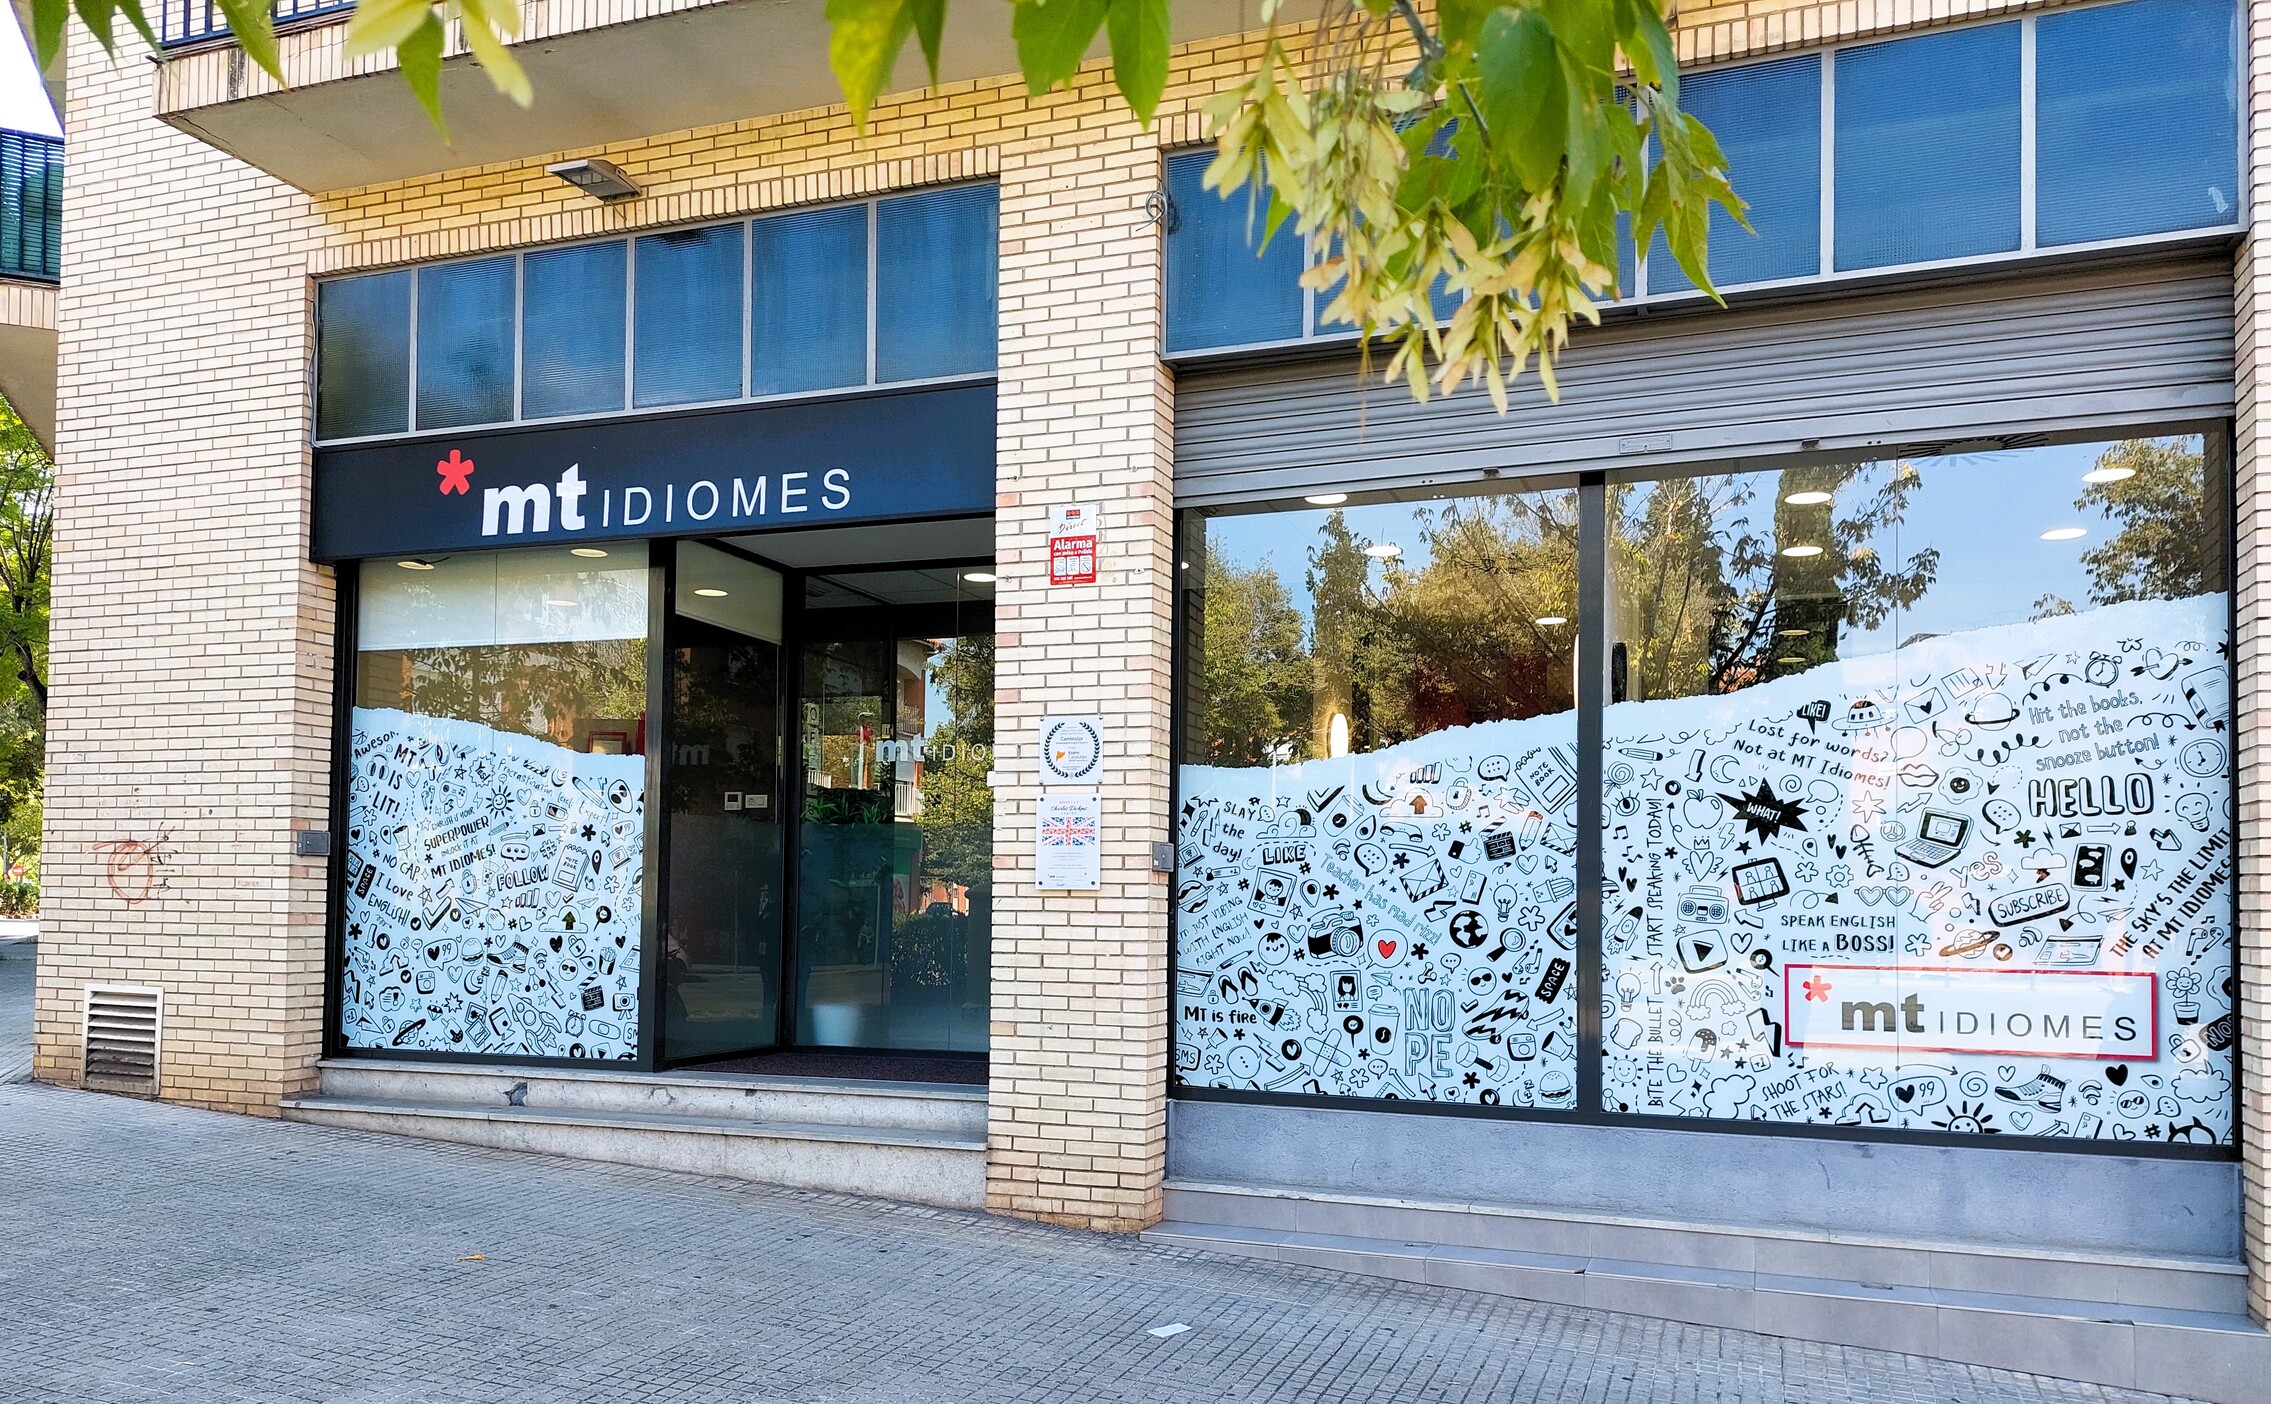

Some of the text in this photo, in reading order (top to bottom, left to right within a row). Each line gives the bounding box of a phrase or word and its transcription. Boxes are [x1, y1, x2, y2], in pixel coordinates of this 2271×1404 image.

[481, 462, 852, 537] mt IDIOMES
[1053, 539, 1093, 550] Alarma
[1801, 701, 1827, 718] LIKE!
[2028, 706, 2054, 725] Hit
[2058, 700, 2087, 719] the
[1749, 719, 1889, 763] Lost for words?
[2058, 717, 2124, 743] not the
[394, 743, 417, 767] MT
[876, 733, 987, 762] mt IDIO
[2036, 732, 2160, 772] snooze button!
[1529, 761, 1549, 780] NOTE
[1535, 767, 1555, 787] BOOK
[1733, 739, 1891, 790] Not at MT Idiomes!
[388, 770, 402, 790] IS
[372, 791, 400, 819] LIT!
[2028, 772, 2154, 818] HELLO
[1223, 801, 1257, 821] SLAY
[1646, 798, 1665, 849] TODAY!
[1746, 802, 1782, 824] WHAT!
[424, 815, 490, 851] SUPERPOWER
[1222, 822, 1245, 839] the
[382, 854, 398, 868] NO
[431, 843, 497, 879] MT IDIOMES!
[1213, 841, 1243, 863] day!
[1262, 845, 1307, 866] LIKE
[357, 867, 374, 895] SPACE
[496, 863, 550, 891] FOLLOW
[1320, 852, 1443, 946] Teacher has mad rizz!
[1997, 888, 2064, 919] SUBSCRIBE
[2110, 826, 2231, 957] THE SKY'S THE LIMIT
[1191, 914, 1209, 934] JUST
[1211, 896, 1243, 919] VIBING
[1211, 912, 1249, 939] ENGLISH
[1780, 914, 1896, 930] SPEAK ENGLISH
[1646, 914, 1664, 958] START
[1782, 933, 1895, 954] LIKE A BOSS!
[2142, 938, 2164, 959] AT
[2156, 916, 2185, 941] MT
[1195, 943, 1225, 966] RIGHT
[1540, 960, 1566, 998] SPACE
[1184, 1005, 1207, 1022] MT
[1211, 1009, 1224, 1023] is
[1403, 987, 1456, 1032] NO
[1646, 996, 1663, 1043] BULLET
[1841, 992, 2137, 1042] mt IDIOMES
[2202, 1015, 2232, 1048] NO
[1175, 1048, 1197, 1065] SMS
[1404, 1031, 1455, 1079] PE
[1646, 1048, 1664, 1075] THE
[1753, 1057, 1767, 1068] +1
[1762, 1061, 1840, 1102] SHOOT FOR
[1918, 1081, 1936, 1098] 99
[1769, 1081, 1848, 1121] THE STARS!
